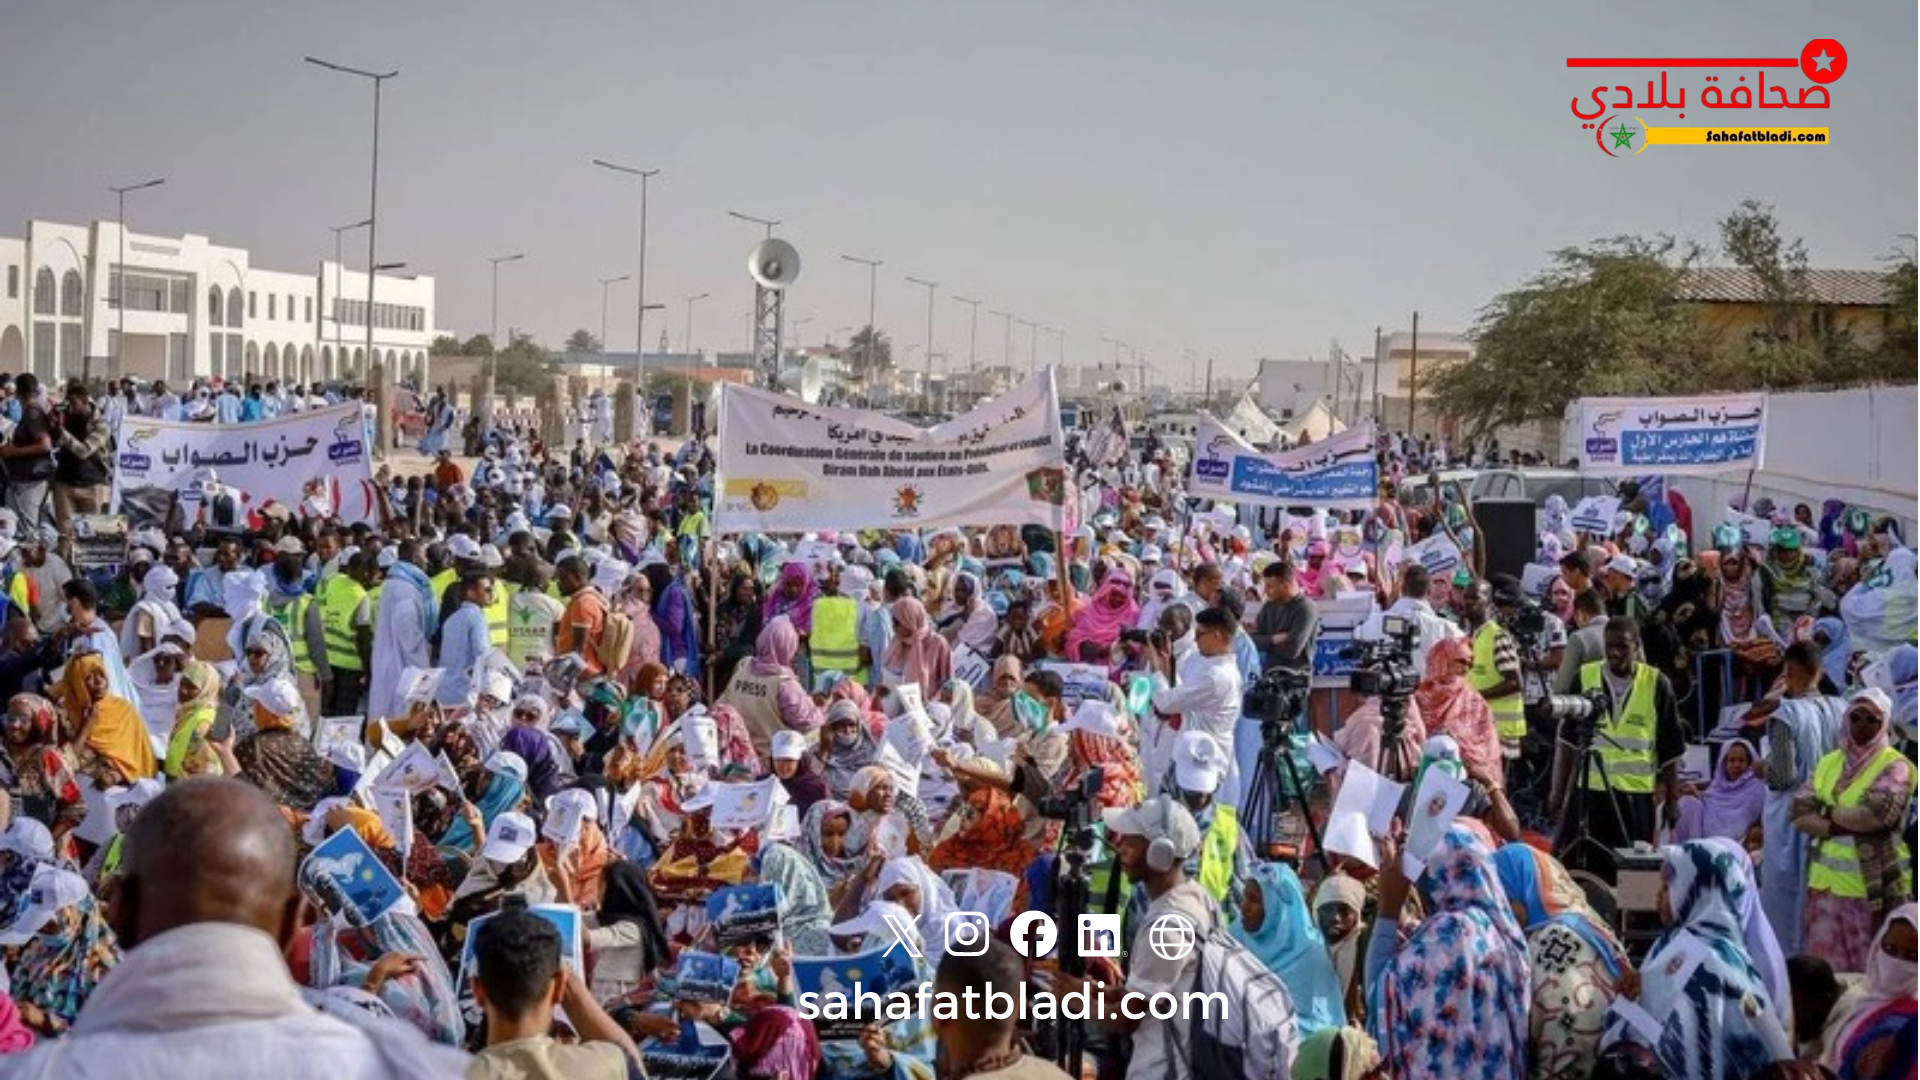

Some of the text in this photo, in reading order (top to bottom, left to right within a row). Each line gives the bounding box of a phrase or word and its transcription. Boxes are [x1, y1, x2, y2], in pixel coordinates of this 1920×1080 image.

[1639, 407, 1704, 428] الصواب
[162, 434, 318, 472] حزب الصواب
[760, 442, 833, 459] Coordination
[889, 449, 902, 460] de
[735, 680, 766, 697] PRESS
